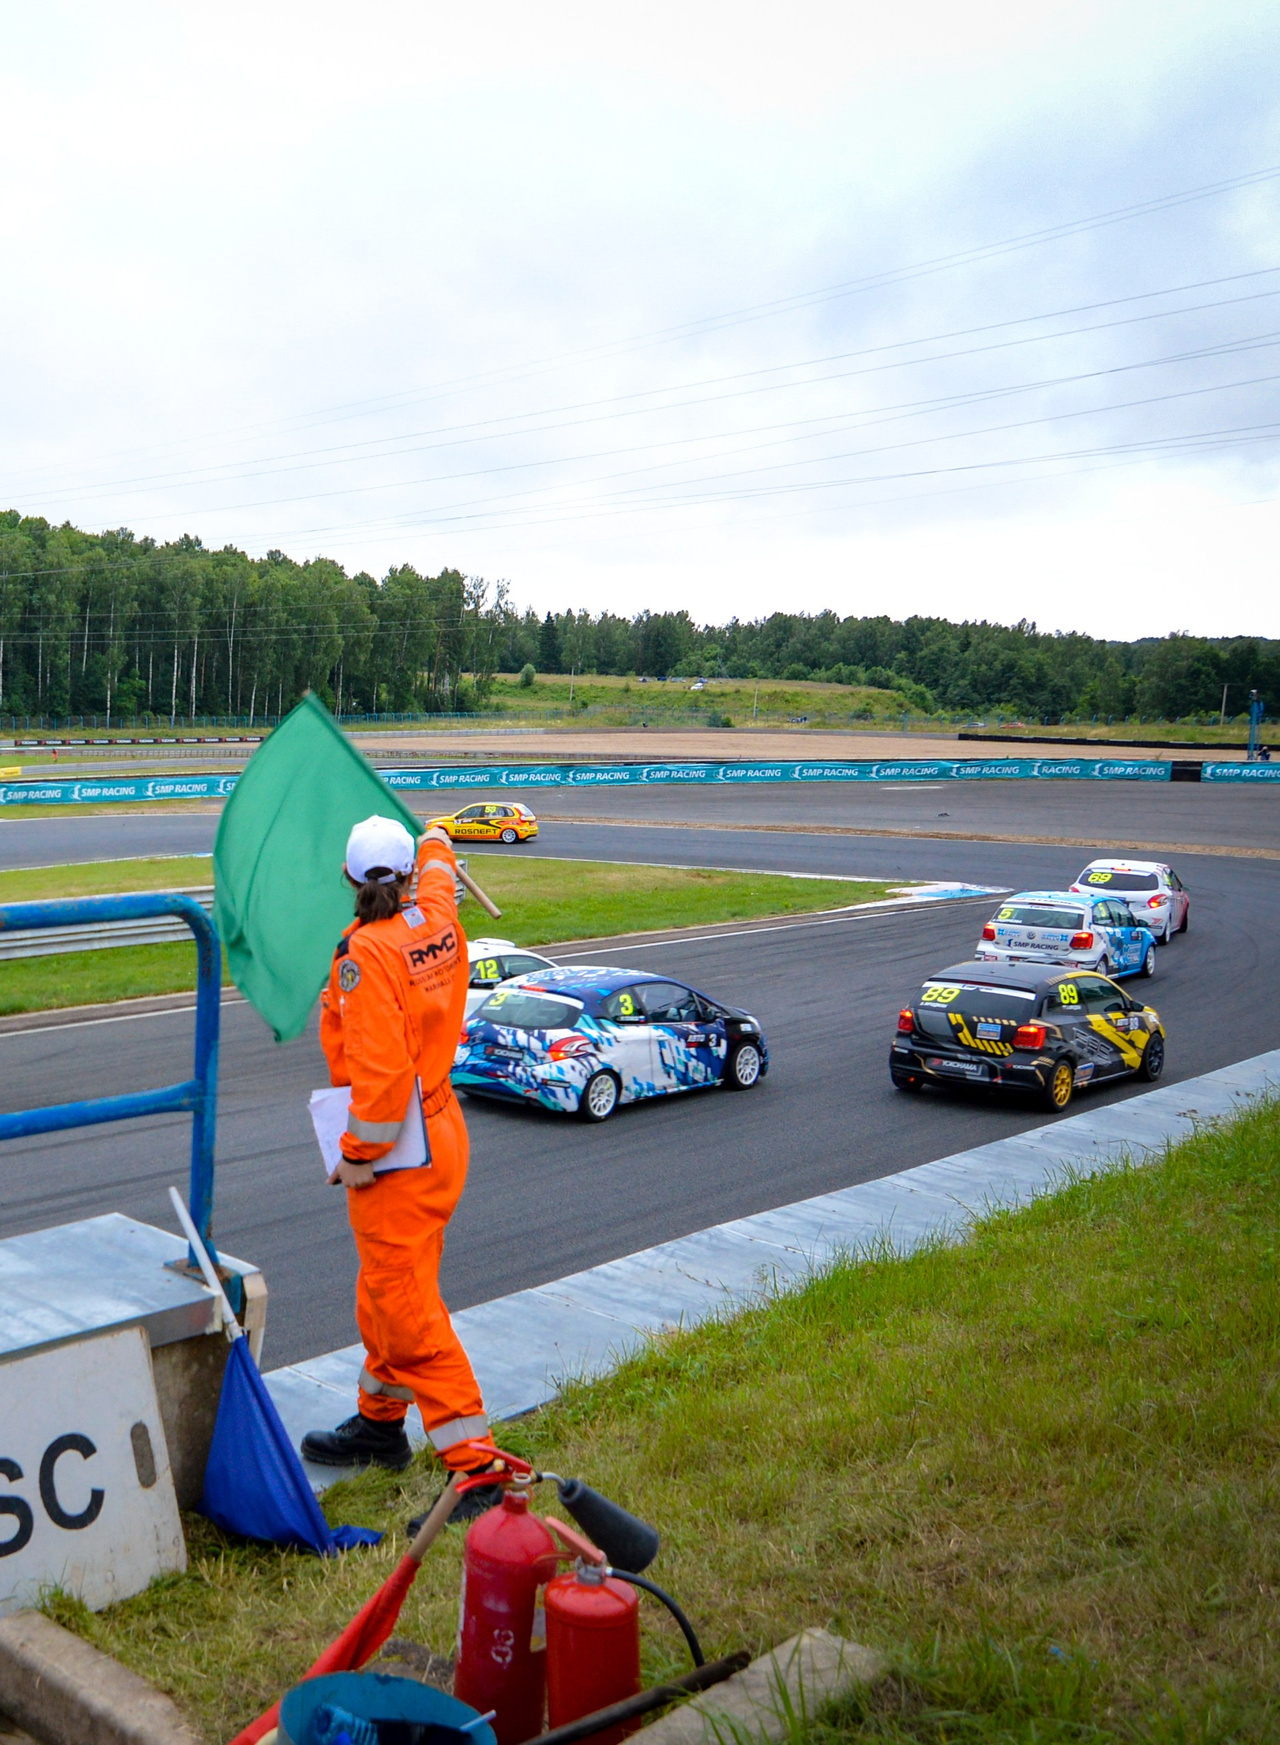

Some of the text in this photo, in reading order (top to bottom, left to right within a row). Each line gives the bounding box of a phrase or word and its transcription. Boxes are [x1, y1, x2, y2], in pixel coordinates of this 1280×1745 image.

[649, 769, 706, 779] SMP RACING
[726, 769, 781, 777] SMP RACING
[802, 768, 858, 776] SMP RACING
[879, 767, 938, 776] SMP RACING
[959, 766, 1019, 775] SMP RACING
[1041, 766, 1080, 774] RACING
[1102, 766, 1165, 775] SMP RACING
[1215, 768, 1240, 777] SMP
[389, 775, 421, 784] RACING
[439, 774, 490, 783] SMP RACING
[509, 773, 561, 782] SMP RACING
[575, 771, 630, 781] SMP RACING
[81, 786, 135, 797] SMP RACING
[155, 783, 207, 794] SMP RACING
[7, 789, 62, 800] SMP RACING
[1088, 872, 1113, 883] 69
[998, 907, 1015, 919] 5
[1030, 942, 1059, 951] RACING
[475, 959, 499, 979] 12
[921, 987, 960, 1003] 89
[1058, 984, 1078, 1004] 89
[619, 994, 634, 1015] 3
[708, 1033, 717, 1047] 3
[942, 1060, 978, 1071] YOKOHAMA
